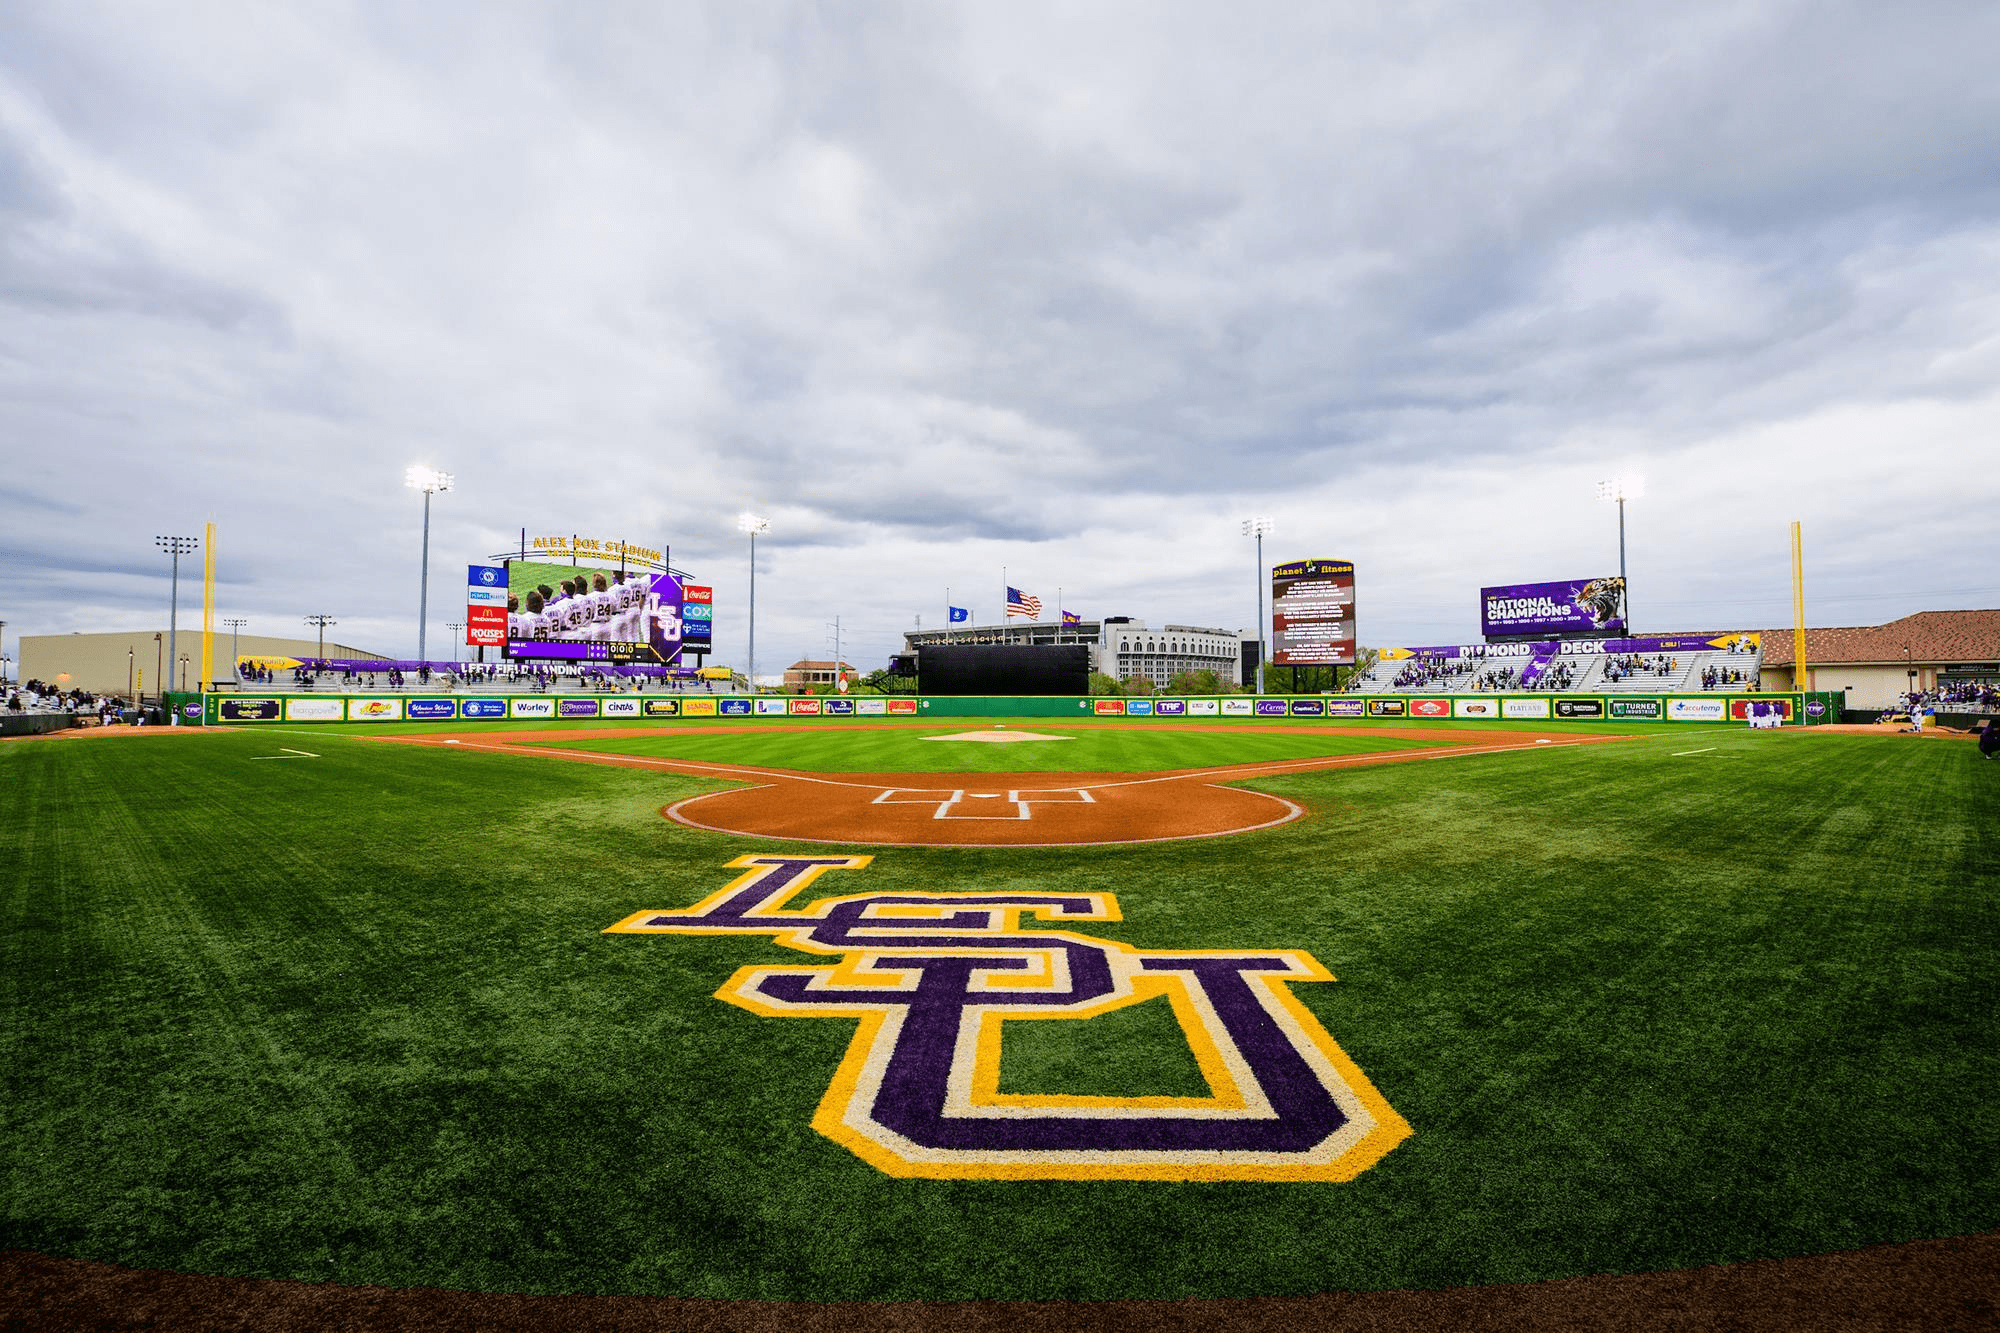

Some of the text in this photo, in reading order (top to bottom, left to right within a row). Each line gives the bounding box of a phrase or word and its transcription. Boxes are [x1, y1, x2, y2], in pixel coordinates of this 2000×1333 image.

[533, 537, 661, 561] ALEX BOX STADIUM
[1274, 568, 1303, 577] planet
[1321, 566, 1352, 574] fitness
[1487, 597, 1555, 610] NATIONAL
[597, 604, 611, 616] 24
[683, 606, 711, 617] COX
[1487, 605, 1572, 620] CHAMPIONS
[471, 628, 504, 639] ROUSES
[534, 627, 548, 639] 25
[1560, 641, 1606, 655] DECK
[517, 703, 549, 712] Worley
[602, 855, 1414, 1182] LSU
